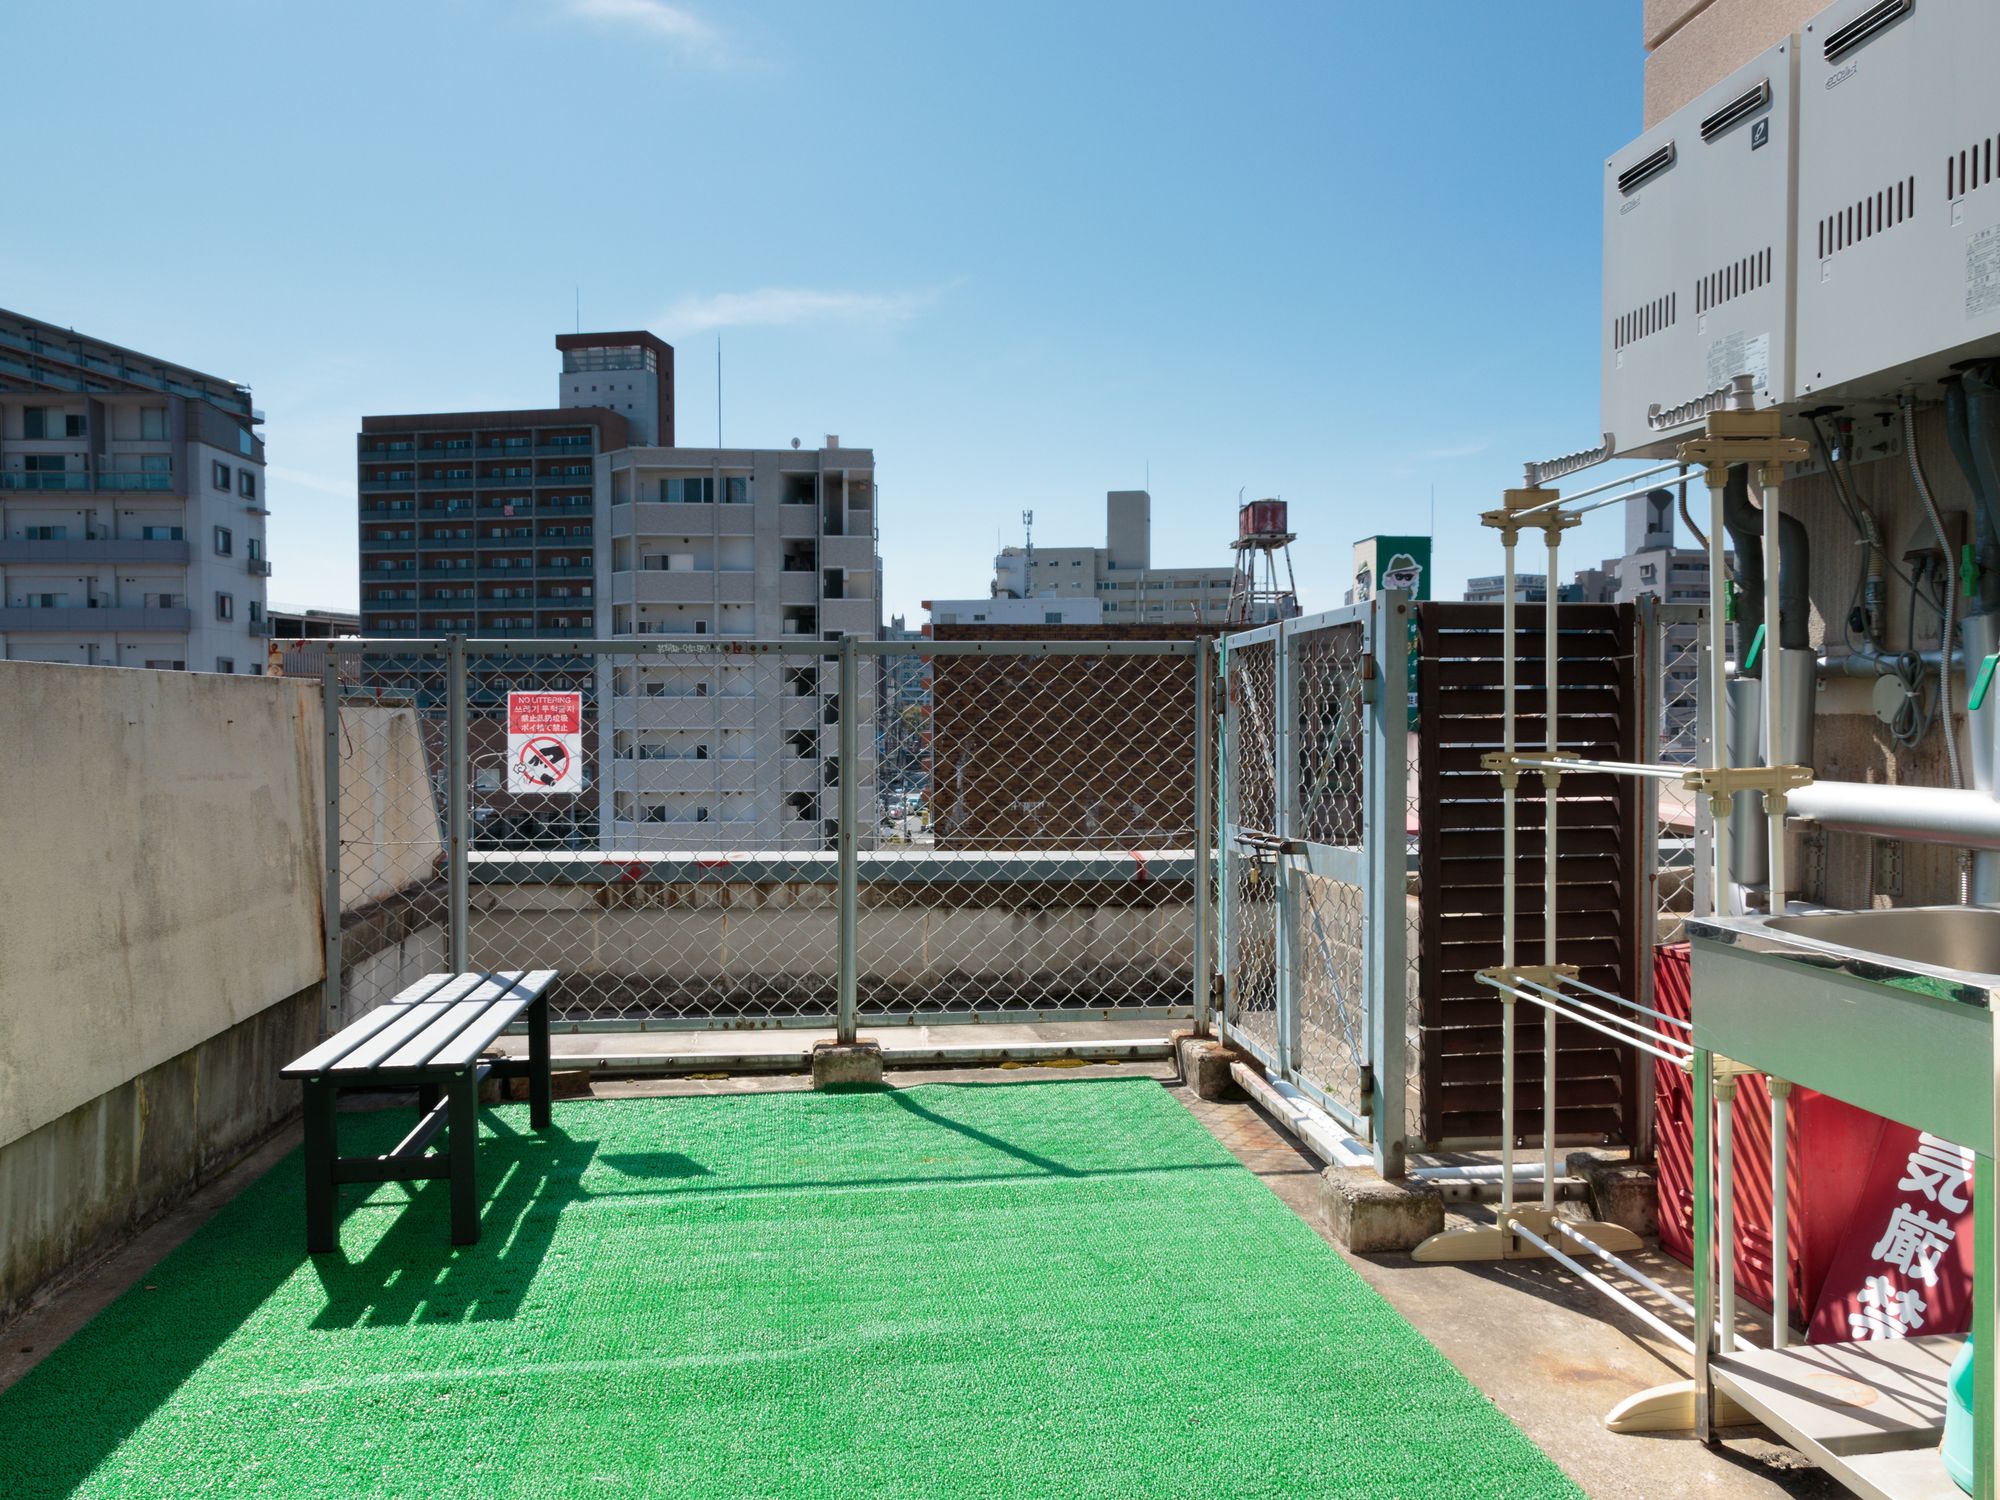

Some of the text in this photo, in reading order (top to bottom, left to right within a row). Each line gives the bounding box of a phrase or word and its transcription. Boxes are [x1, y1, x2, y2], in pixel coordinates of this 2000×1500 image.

[514, 705, 540, 713] 쓰레기
[521, 724, 568, 732] ポイ捨て禁止
